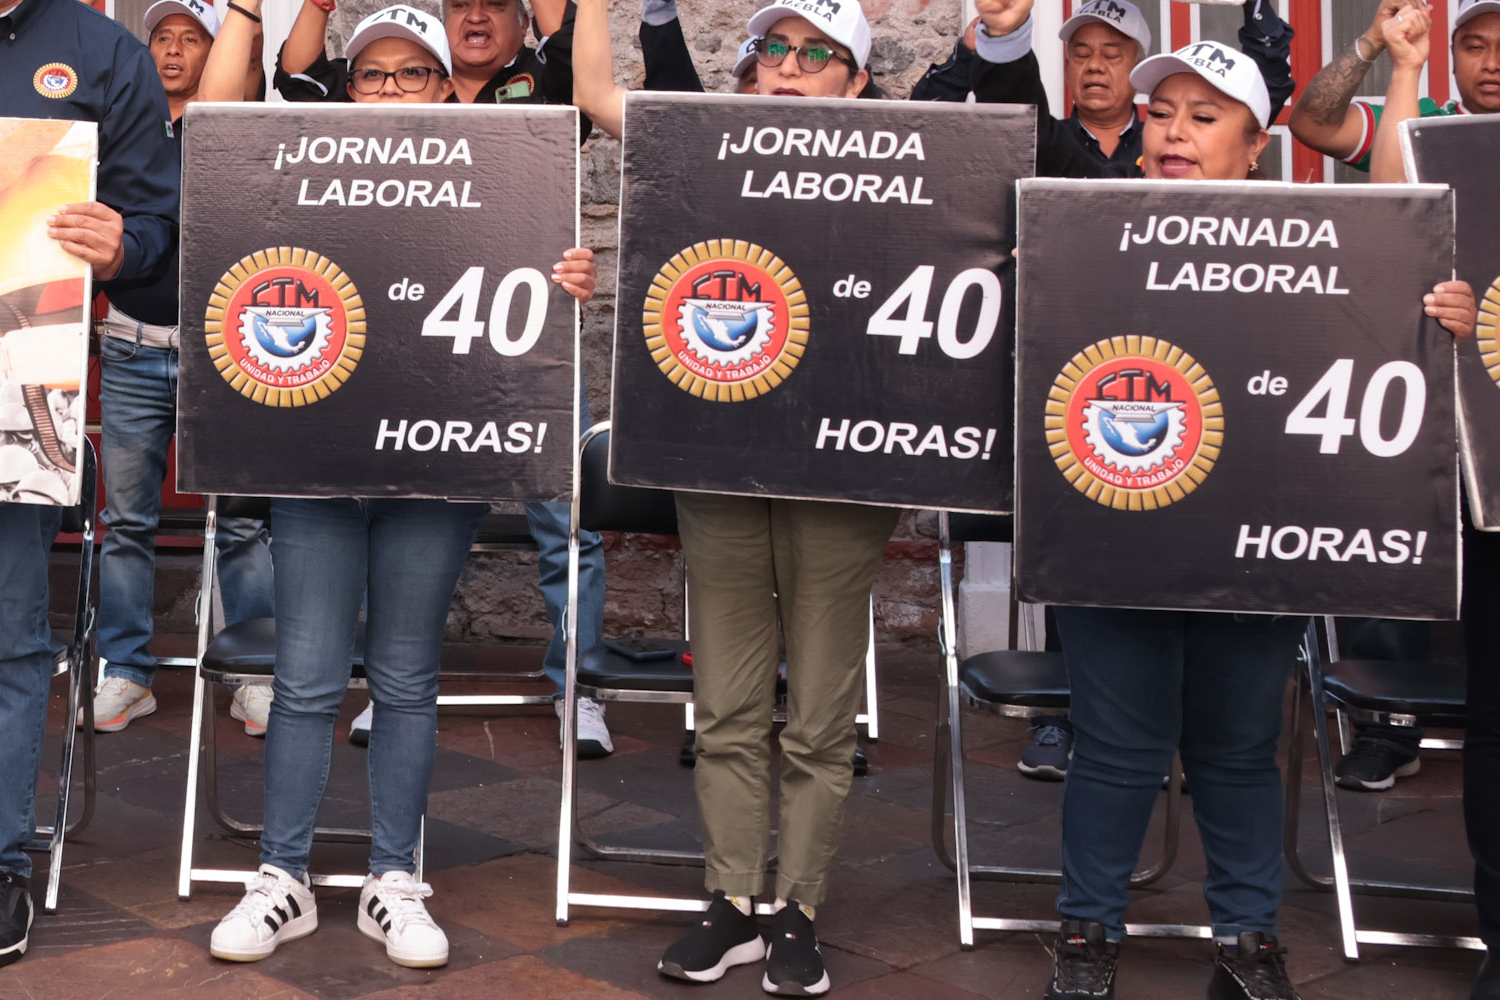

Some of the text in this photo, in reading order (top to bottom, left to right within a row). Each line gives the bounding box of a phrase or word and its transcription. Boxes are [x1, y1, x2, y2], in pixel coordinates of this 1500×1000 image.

[274, 137, 472, 170] ¡JORNADA
[718, 127, 925, 160] ¡JORNADA
[298, 179, 481, 207] LABORAL
[741, 170, 933, 204] LABORAL
[1120, 216, 1339, 251] ¡JORNADA
[251, 277, 319, 308] CTM
[692, 271, 761, 302] CTM
[1146, 262, 1349, 294] LABORAL
[388, 267, 548, 356] de 40
[706, 303, 746, 311] NACIONAL
[833, 265, 1001, 359] de 40
[240, 358, 275, 383] UNIDAD
[287, 359, 330, 385] TRABAJO
[678, 351, 714, 377] UNIDAD
[726, 355, 771, 378] TRABAJO
[1097, 368, 1171, 402] CTM
[1112, 404, 1156, 412] NACIONAL
[1248, 359, 1426, 457] de 40
[375, 419, 547, 453] HORAS!
[816, 418, 996, 459] HORAS!
[1084, 456, 1123, 483] UNIDAD
[1137, 459, 1184, 486] TRABAJO
[1235, 525, 1427, 564] HORAS!
